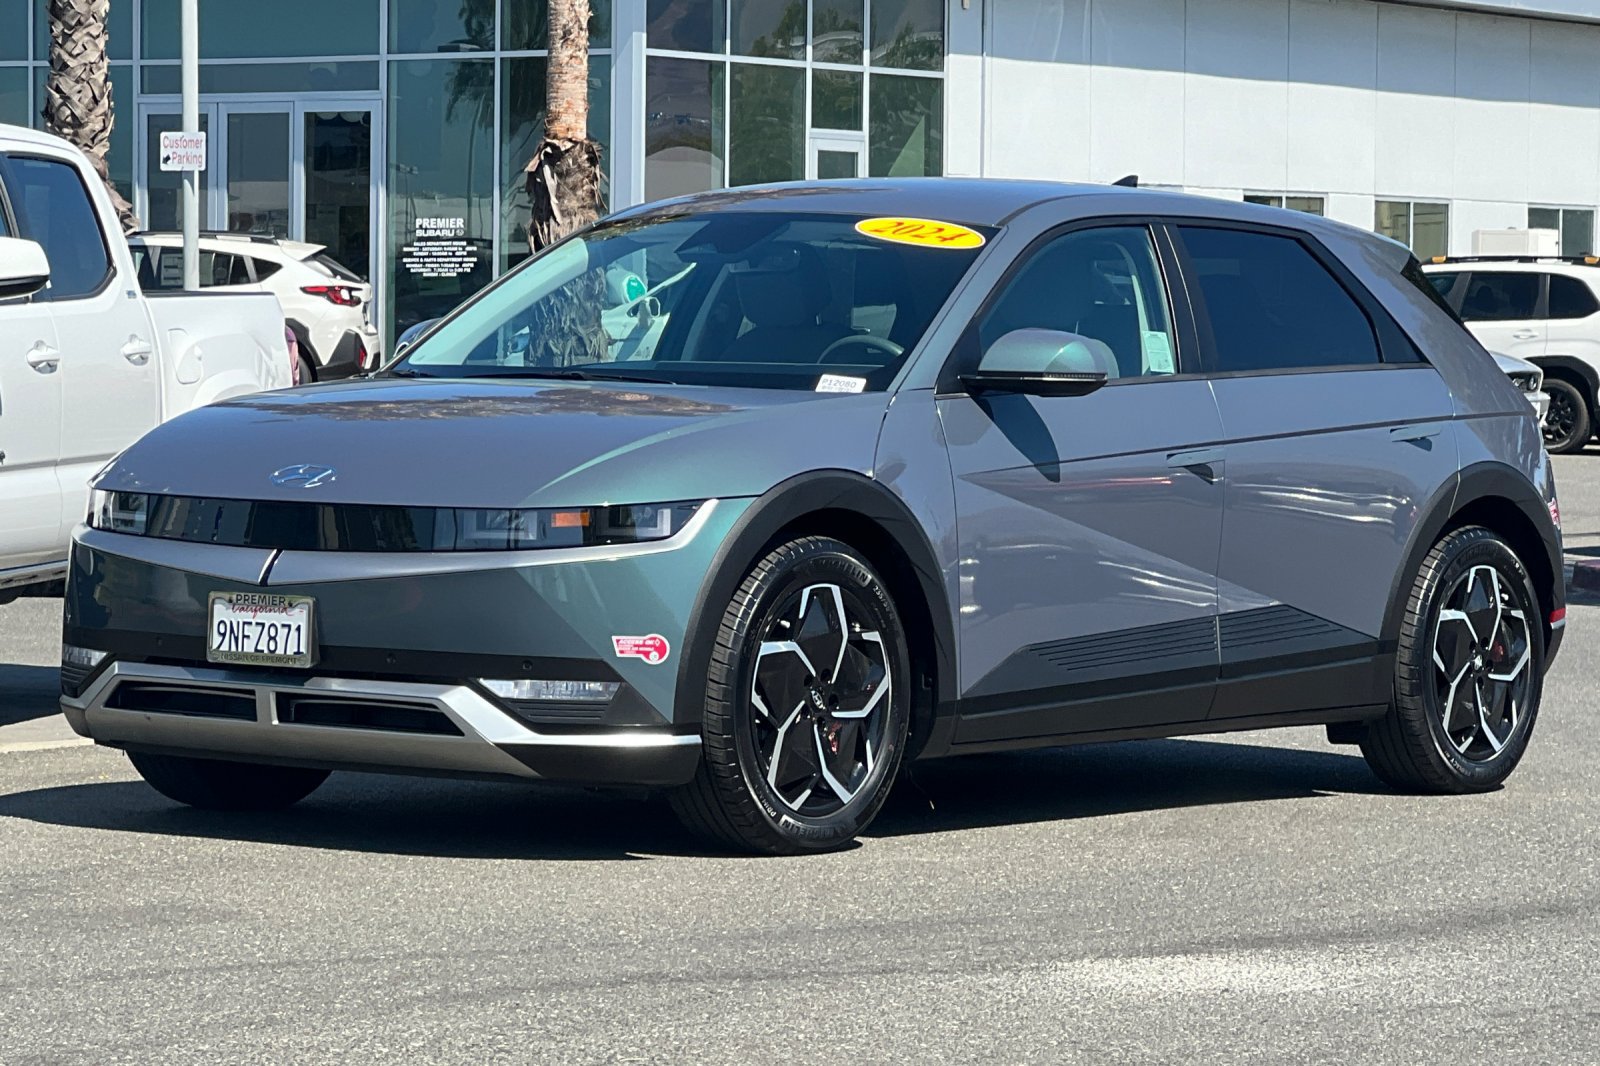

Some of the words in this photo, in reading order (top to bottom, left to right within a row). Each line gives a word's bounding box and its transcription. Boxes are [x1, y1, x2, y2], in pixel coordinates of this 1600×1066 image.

[163, 135, 203, 149] Customer
[172, 151, 203, 168] Parking
[415, 217, 464, 228] PREMIER
[415, 229, 455, 237] SUBARU
[869, 221, 971, 242] 2024
[822, 379, 857, 389] P12080
[235, 594, 286, 606] PREMIER
[231, 604, 295, 619] California
[217, 620, 305, 655] 9NFZ871
[221, 653, 250, 662] NISSAN
